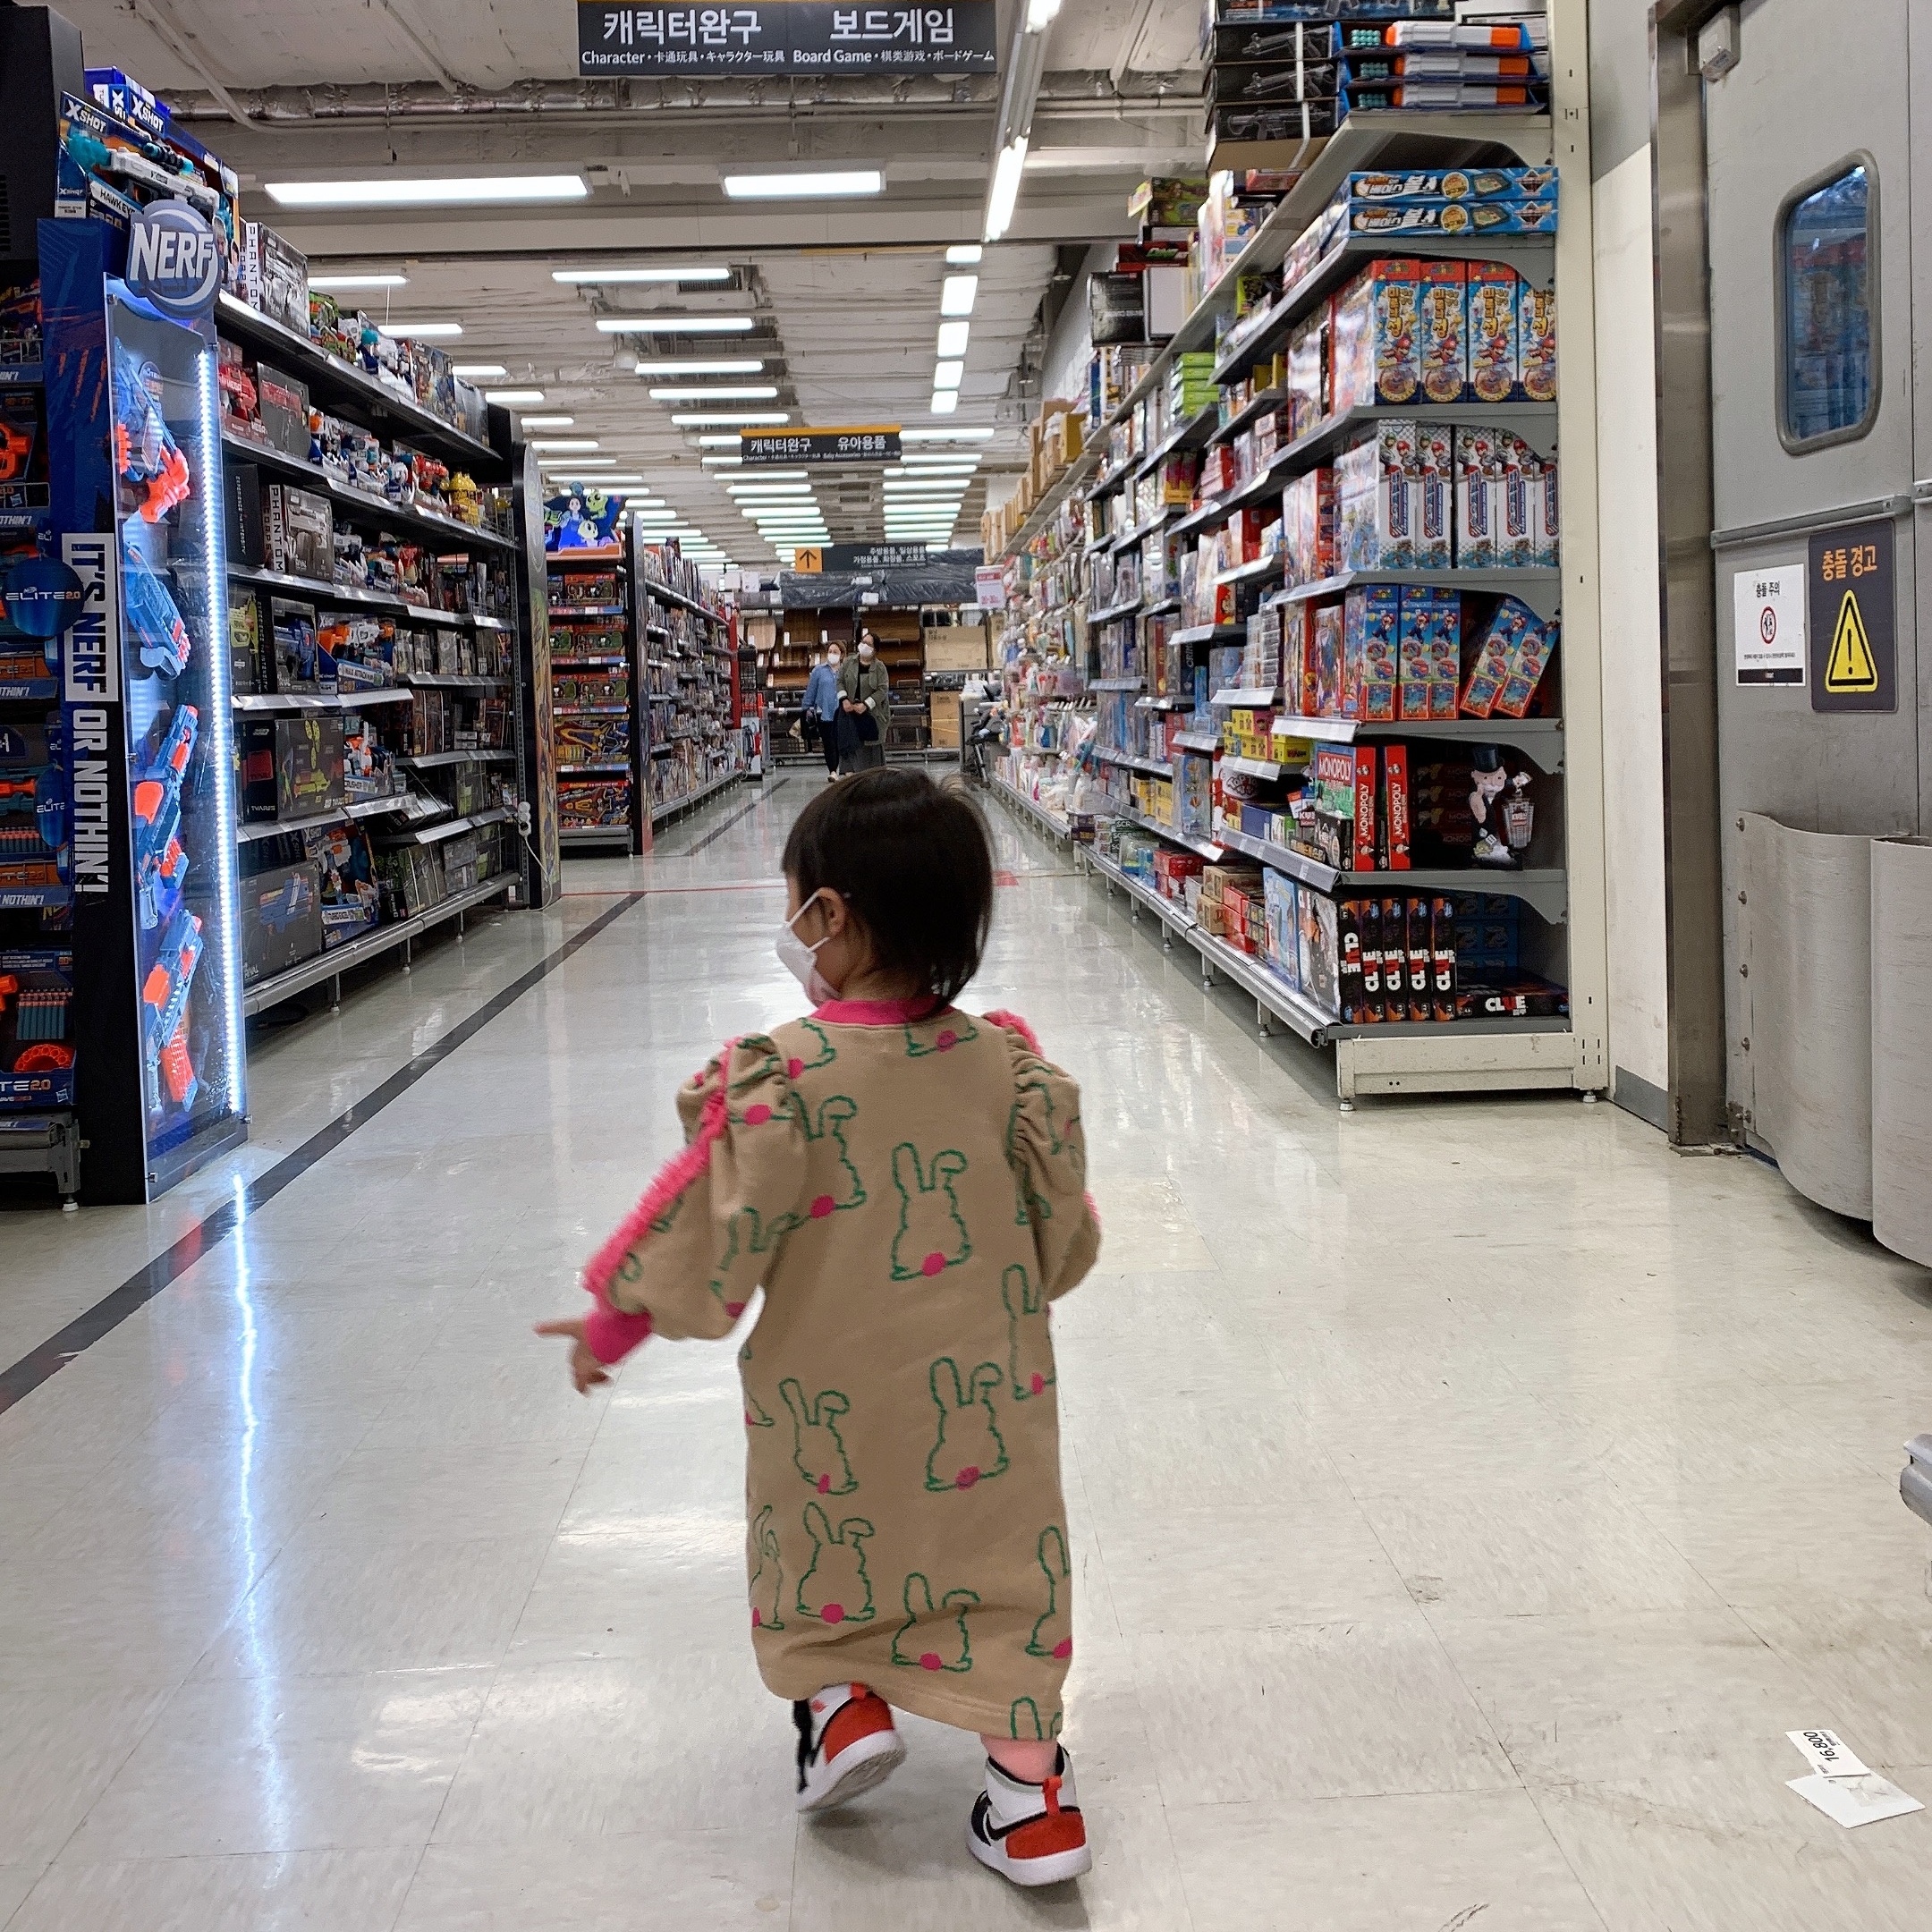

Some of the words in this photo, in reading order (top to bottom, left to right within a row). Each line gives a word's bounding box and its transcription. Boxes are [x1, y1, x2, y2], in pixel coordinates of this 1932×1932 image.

[603, 8, 762, 45] 캐릭터완구
[830, 8, 953, 44] 보드게임
[581, 49, 645, 64] Character
[792, 48, 831, 64] Board
[833, 49, 872, 64] Game
[130, 222, 213, 281] NERF
[750, 436, 812, 453] 캐릭터완구
[837, 435, 886, 451] 유아용품
[271, 487, 284, 572] PHANTOM
[71, 543, 106, 602] IT'S
[1822, 548, 1848, 581] 충돌
[1850, 544, 1877, 578] 경고
[1768, 580, 1781, 597] 주의
[72, 612, 107, 694] NERF
[72, 709, 107, 750] OR
[1318, 756, 1352, 781] MONOPOLY
[73, 760, 109, 893] NOTHIN'!
[1359, 783, 1369, 836] MONOPOLY
[1392, 782, 1402, 835] MONOPOLY
[1343, 932, 1361, 973] CLUE
[1363, 951, 1379, 992] CLUE
[1384, 950, 1402, 991] CLUE
[1410, 949, 1427, 991] CLUE
[1435, 950, 1451, 991] CLUE
[1485, 996, 1526, 1013] CLUE
[1802, 1732, 1840, 1762] 16,800
